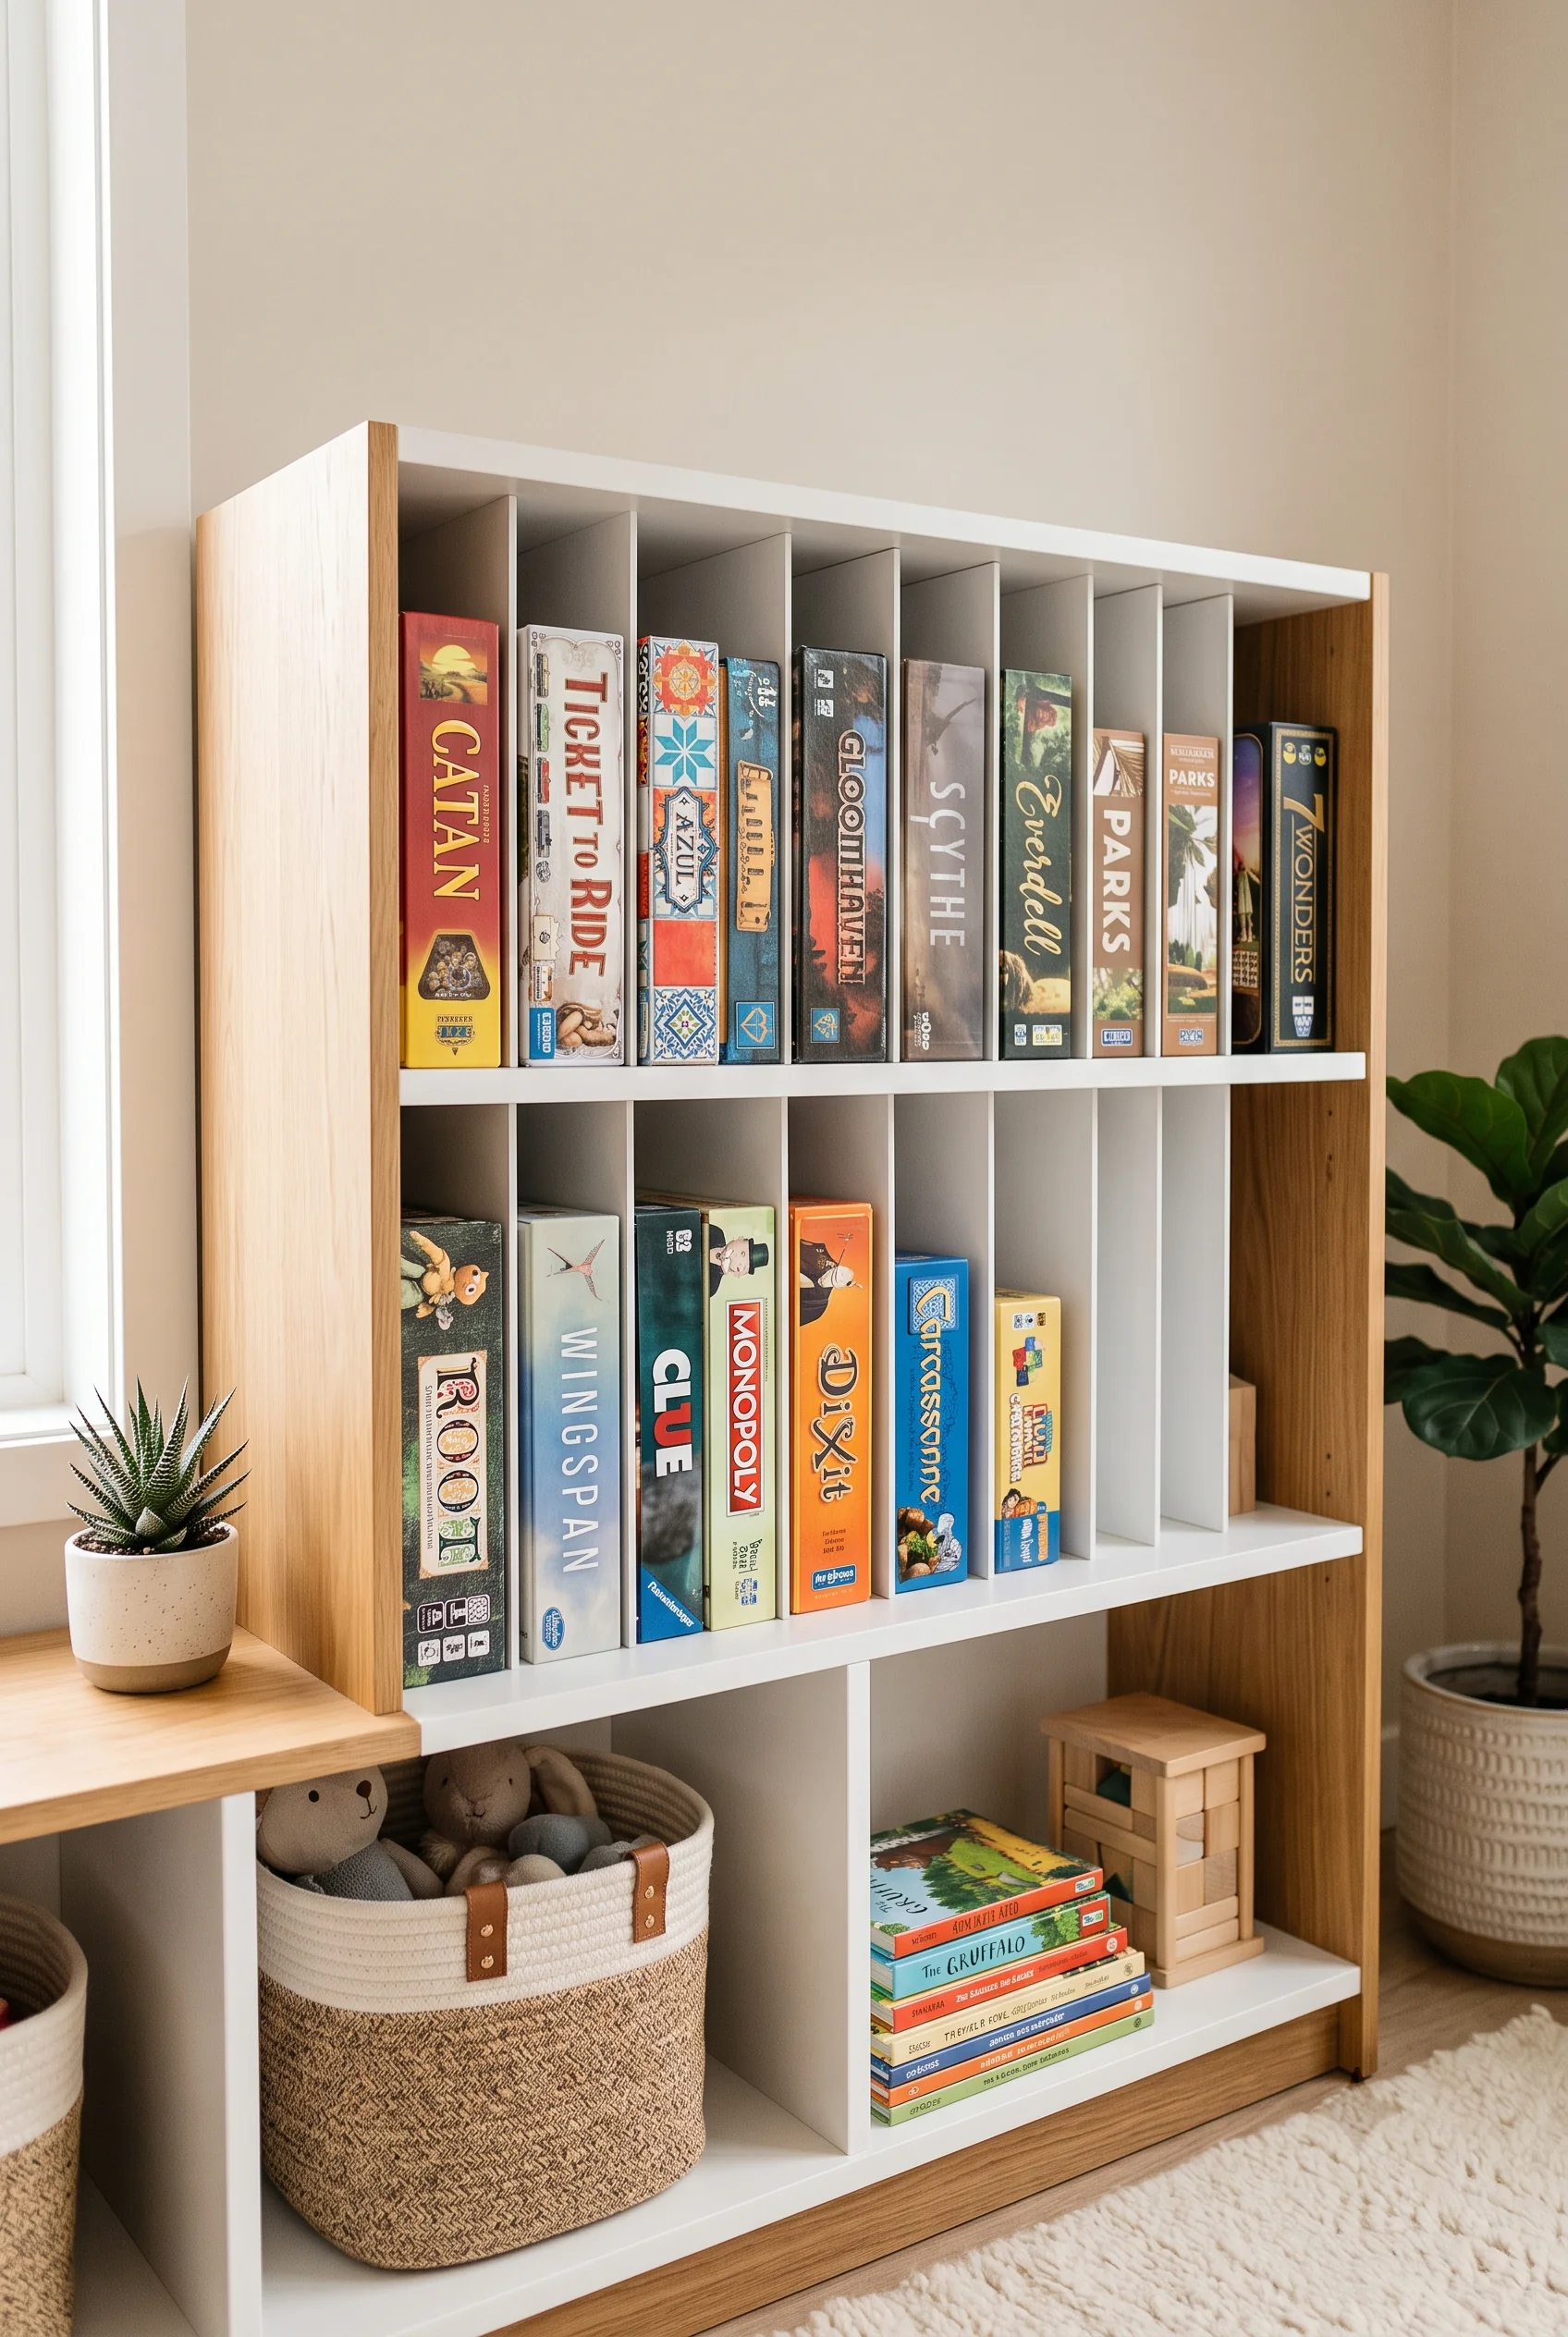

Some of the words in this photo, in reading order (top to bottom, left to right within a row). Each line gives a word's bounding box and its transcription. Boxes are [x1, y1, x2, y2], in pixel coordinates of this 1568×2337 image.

[431, 719, 482, 902] CATAN
[564, 671, 608, 826] TICKET
[1169, 768, 1215, 788] PARKS
[1283, 793, 1325, 832] 7
[569, 878, 612, 978] RIDE
[572, 836, 599, 869] TO
[675, 812, 695, 887] AZUL
[838, 728, 867, 986] GLOOMHAVEN
[910, 781, 966, 947] SCYTHE
[1016, 775, 1062, 956] Everdell
[1103, 809, 1132, 954] PARKS
[1294, 823, 1316, 985] WONDERS
[436, 1356, 482, 1564] ROOT
[561, 1328, 599, 1573] WINGSPAN
[652, 1349, 693, 1478] CLUE
[732, 1309, 760, 1504] MONOPOLY
[915, 1286, 951, 1504] Carcassonne
[947, 1936, 1025, 1976] GRUFFALO
